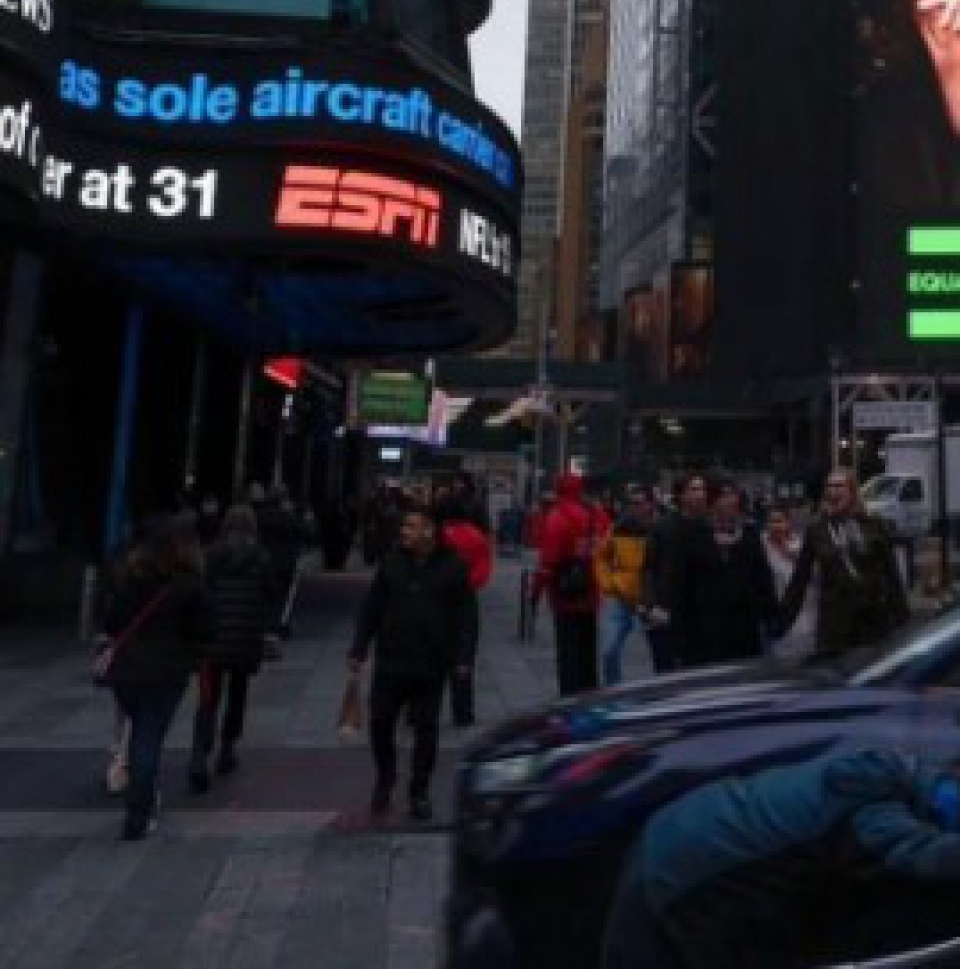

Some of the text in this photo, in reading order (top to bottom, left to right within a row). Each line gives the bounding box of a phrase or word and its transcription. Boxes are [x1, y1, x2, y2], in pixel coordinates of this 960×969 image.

[114, 73, 240, 124] sole
[250, 64, 431, 139] aircraft
[79, 163, 136, 214] at
[146, 167, 219, 220] 31
[273, 163, 445, 250] ESPN
